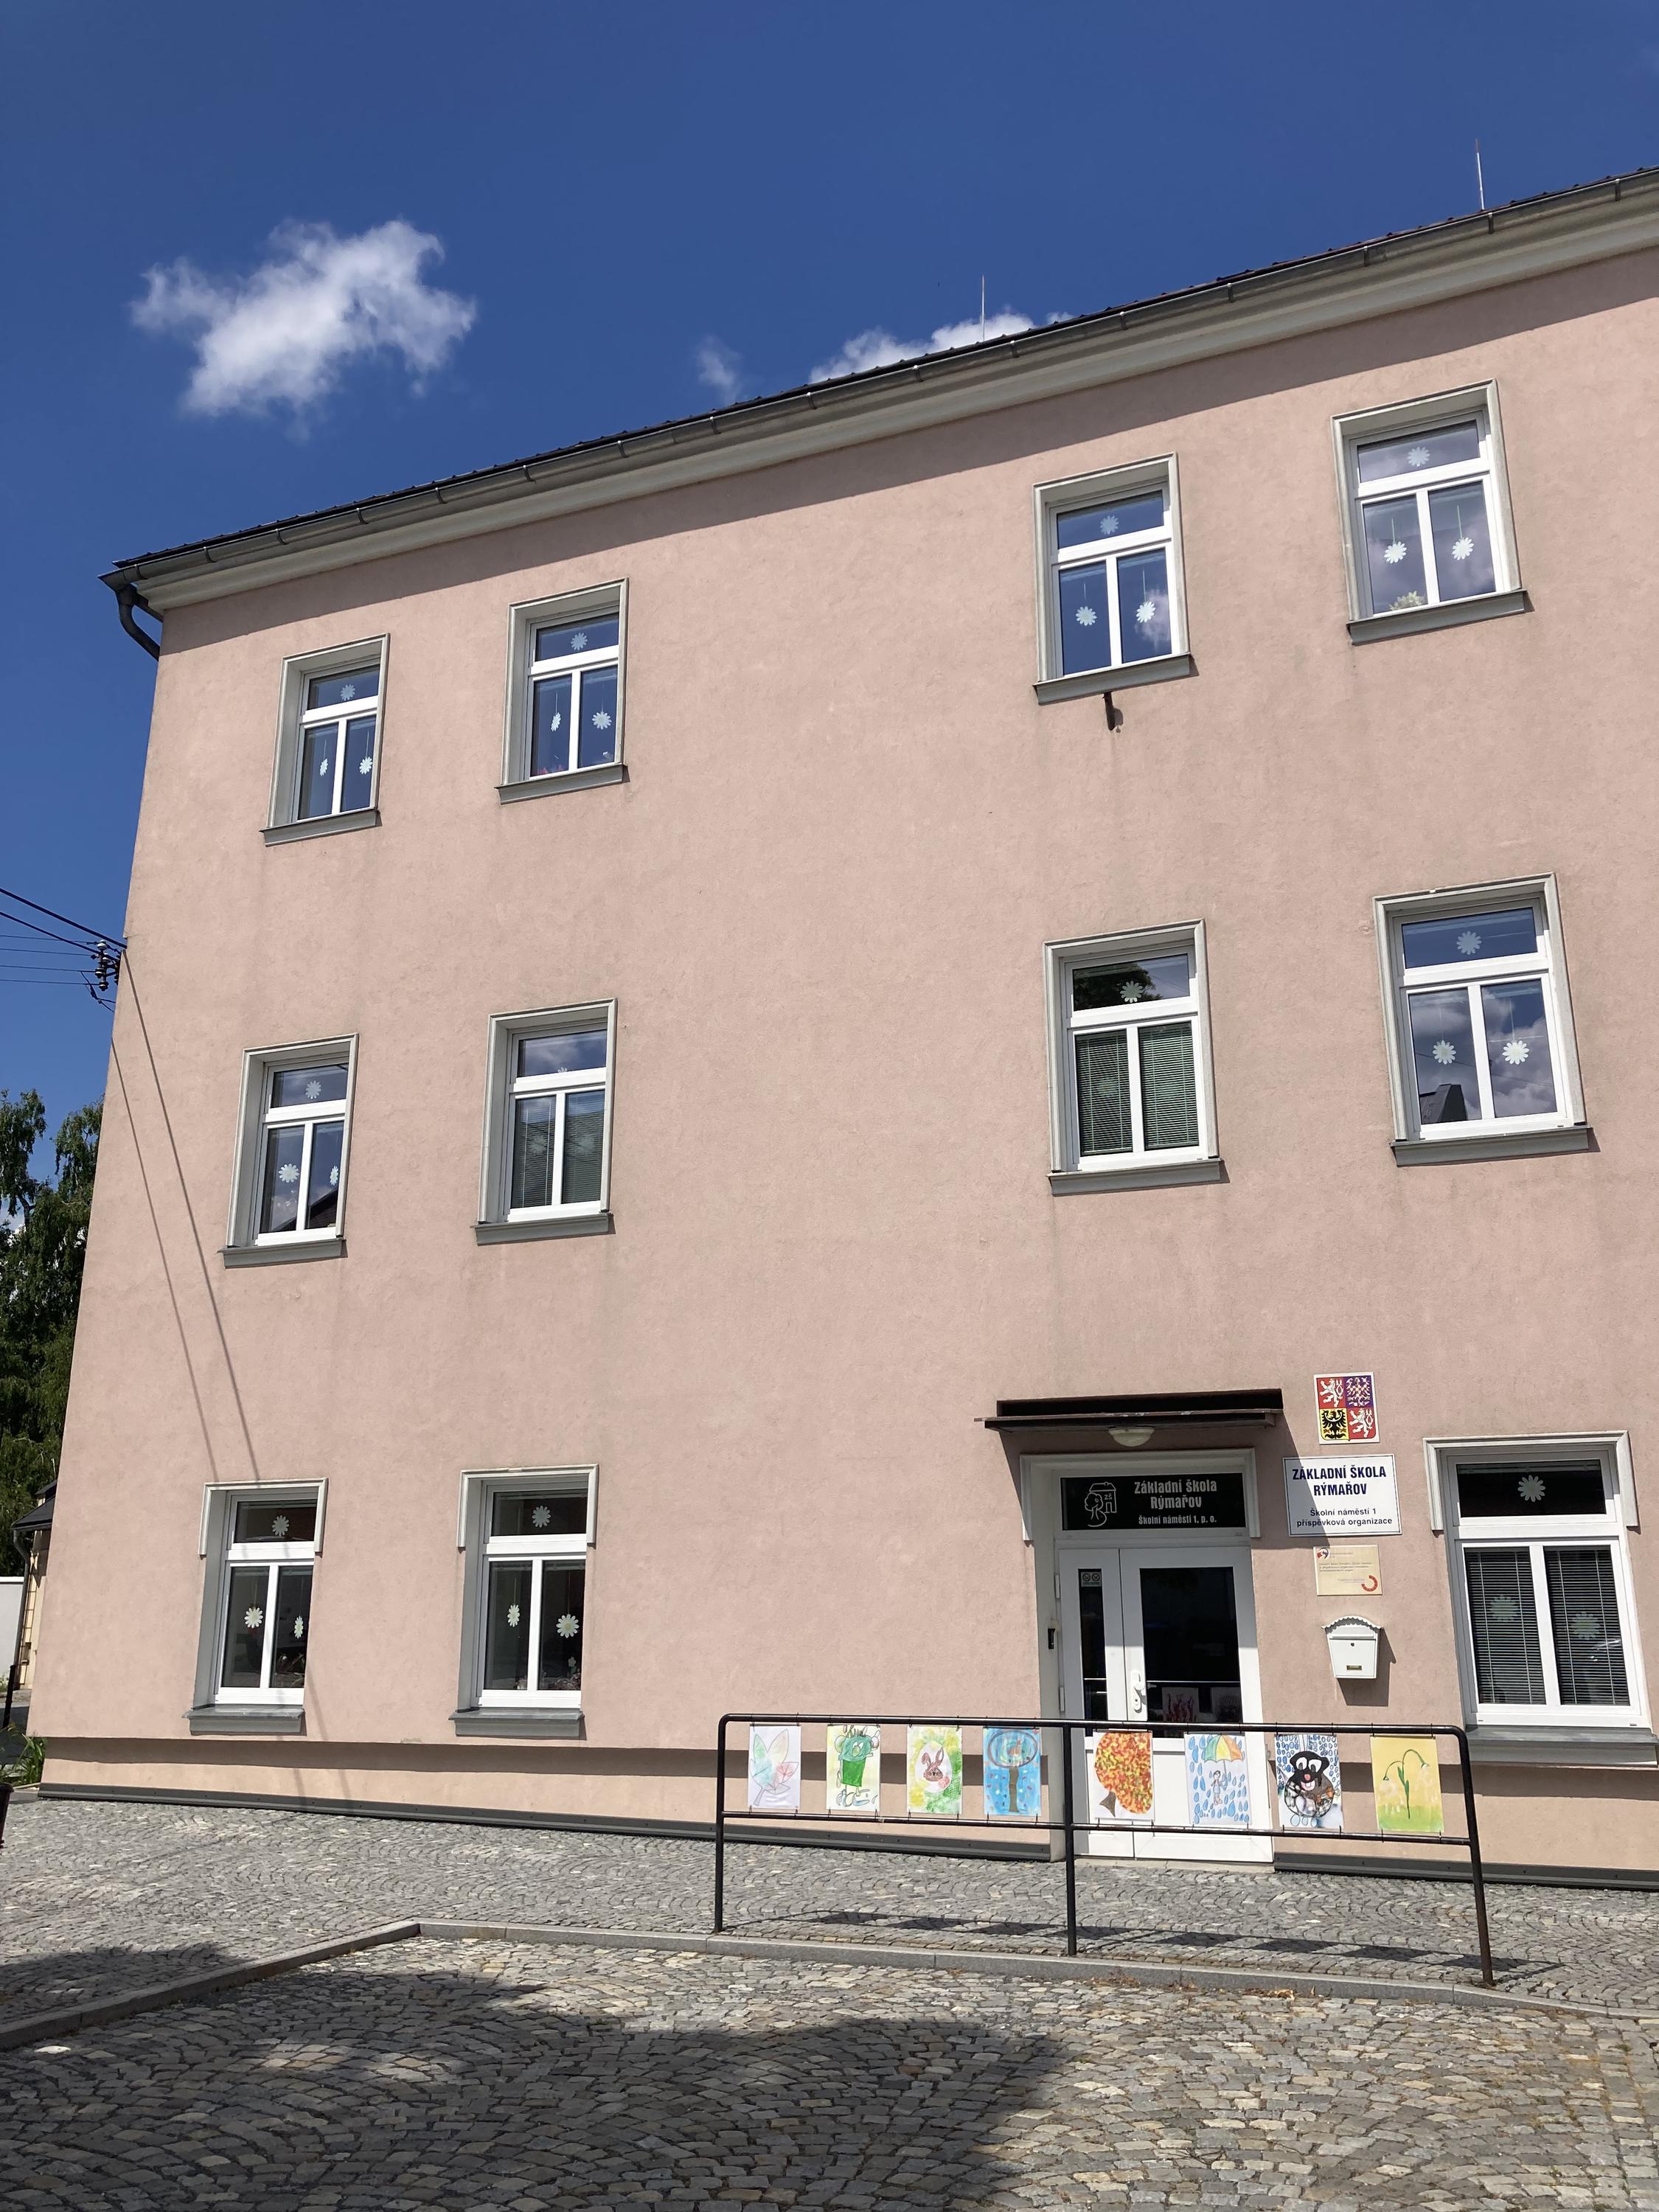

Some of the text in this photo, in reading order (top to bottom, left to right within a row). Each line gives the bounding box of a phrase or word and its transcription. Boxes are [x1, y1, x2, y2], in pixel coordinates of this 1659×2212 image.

[1293, 1464, 1386, 1480] ZÁKLADNÍ ŠKOLA
[1134, 1479, 1217, 1494] Základní škola
[1313, 1481, 1367, 1496] RÝMAŘOV
[1151, 1495, 1202, 1510] Rýmařov
[1138, 1515, 1161, 1525] Školní
[1163, 1514, 1192, 1524] náměstí
[1201, 1516, 1208, 1524] p.
[1310, 1508, 1335, 1517] Školní
[1296, 1517, 1393, 1528] příspěvková organizace
